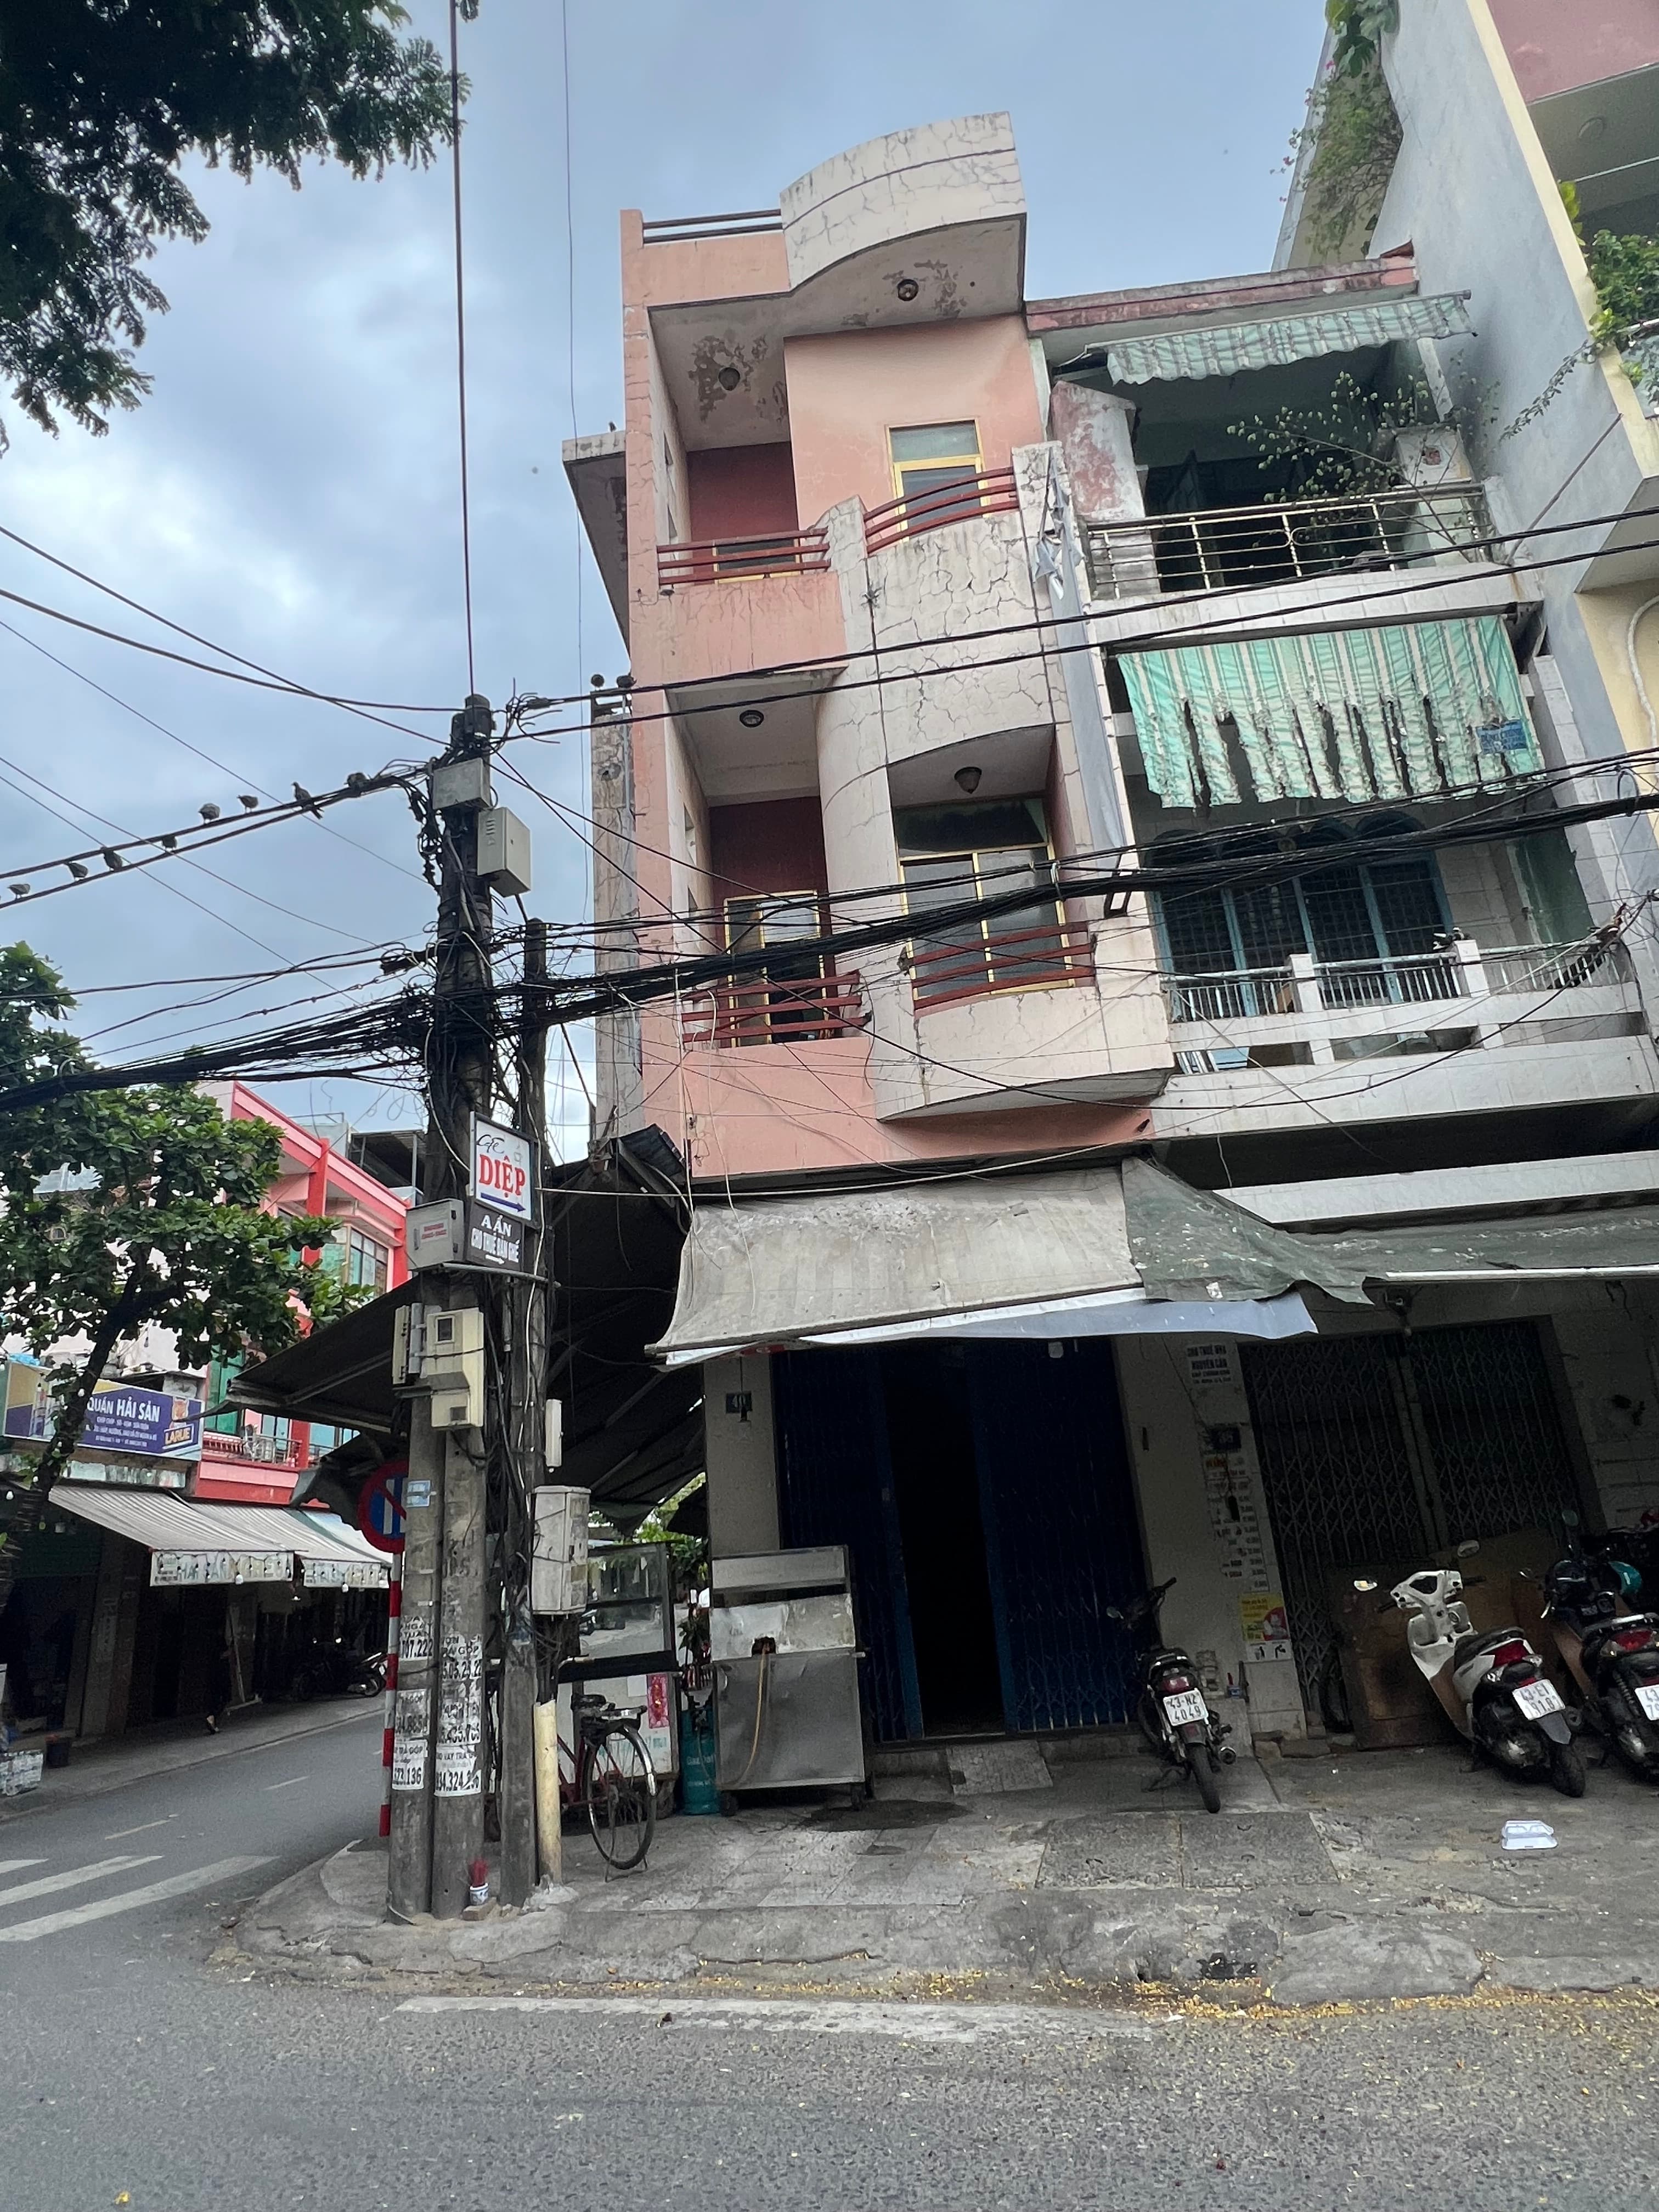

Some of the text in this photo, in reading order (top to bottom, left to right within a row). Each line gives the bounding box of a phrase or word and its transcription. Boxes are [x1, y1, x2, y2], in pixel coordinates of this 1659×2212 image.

[479, 1154, 525, 1198] DIỆP
[87, 1396, 160, 1423] QUÁN HẢI SẢN
[165, 1427, 191, 1445] LARUE
